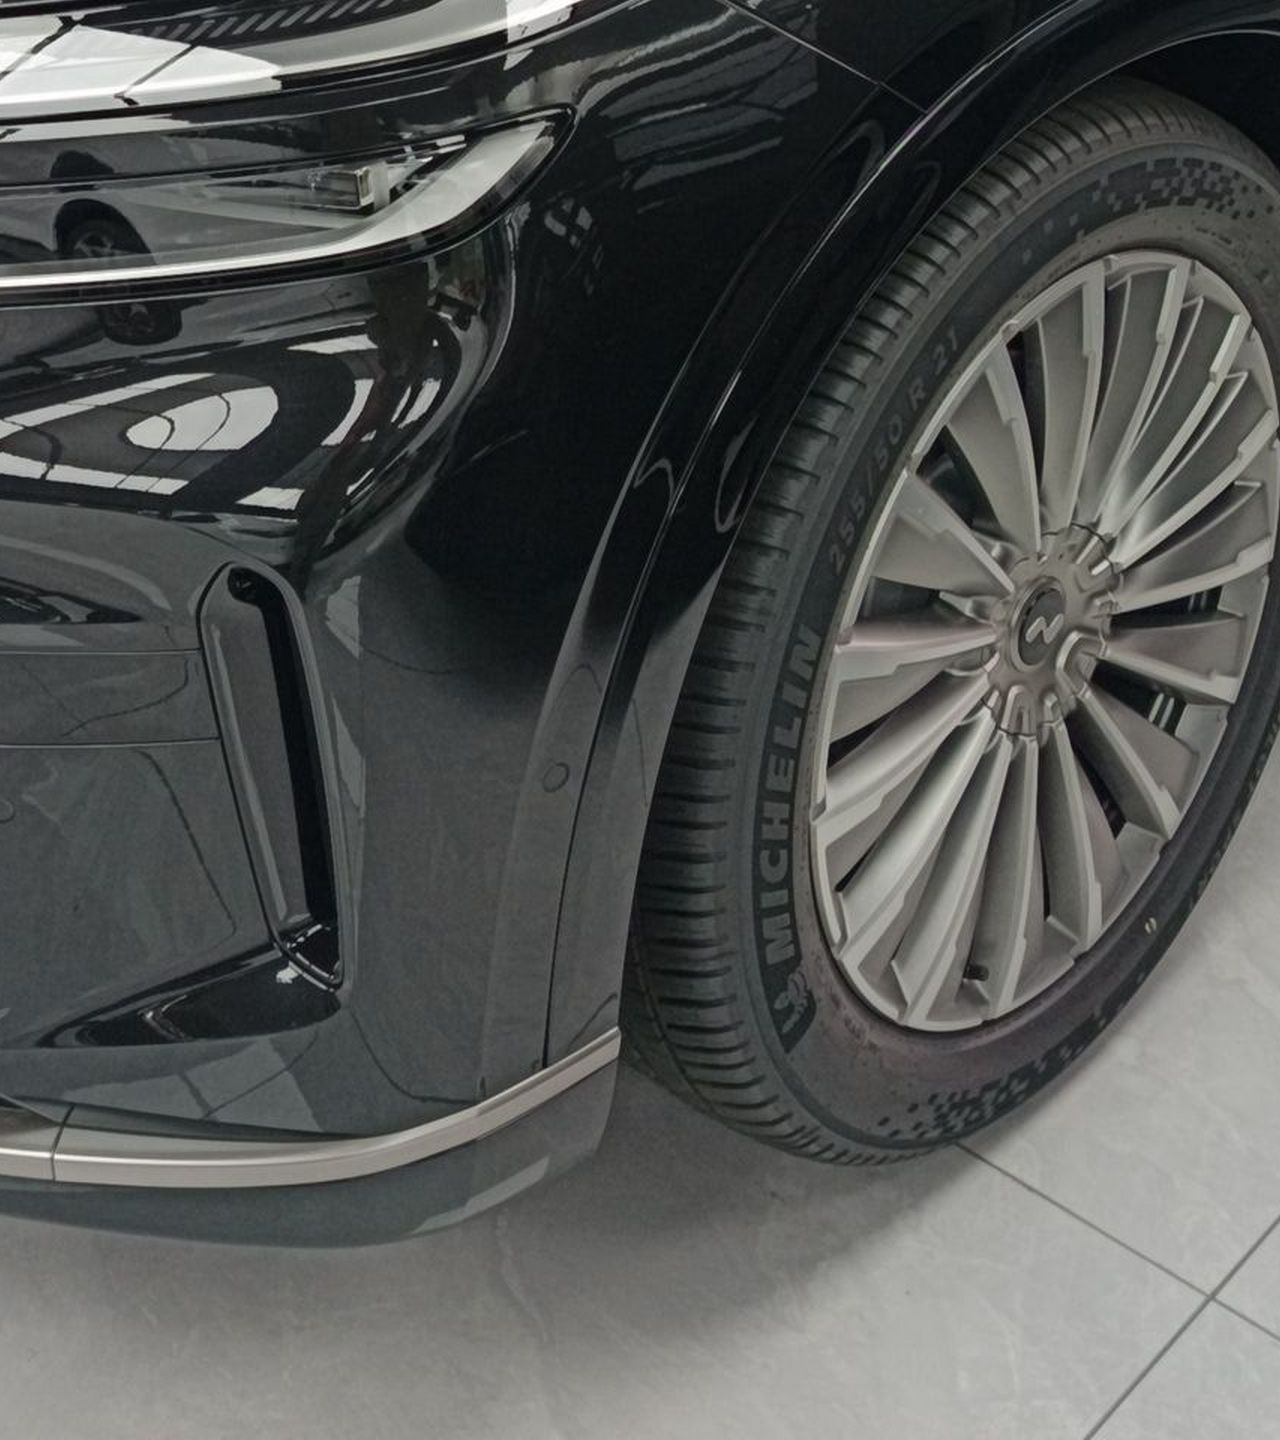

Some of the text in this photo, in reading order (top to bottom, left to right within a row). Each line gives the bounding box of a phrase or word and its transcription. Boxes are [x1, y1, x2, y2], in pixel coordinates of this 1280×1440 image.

[909, 377, 926, 410] R
[933, 325, 958, 376] 21
[760, 623, 821, 965] MICHELIN
